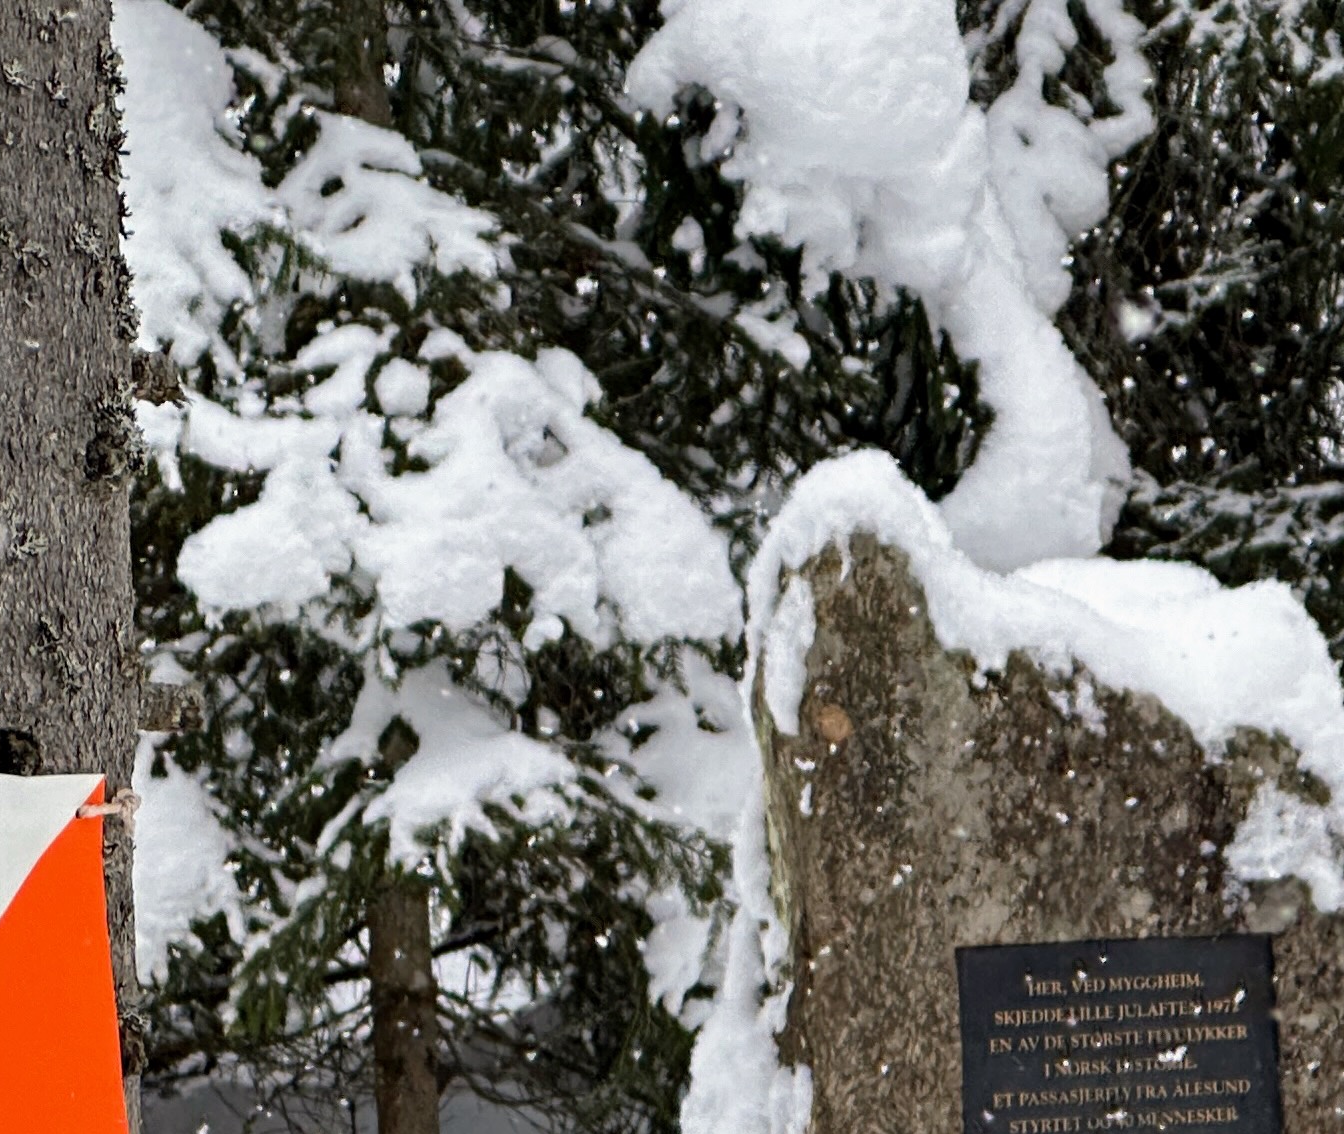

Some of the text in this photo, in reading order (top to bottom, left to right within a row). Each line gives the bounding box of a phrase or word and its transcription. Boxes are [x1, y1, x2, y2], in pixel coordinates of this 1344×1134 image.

[1027, 979, 1067, 997] HER,
[1071, 976, 1105, 993] VED
[994, 1006, 1067, 1028] SKJEDDE
[1068, 1003, 1114, 1023] LILLE
[1117, 1000, 1203, 1021] JULAFTEN
[989, 1037, 1012, 1055] EN
[1018, 1035, 1040, 1052] AV
[1044, 1033, 1066, 1050] DE
[1147, 1025, 1248, 1045] FLYULYKKER
[1044, 1055, 1198, 1078] I NORSK HSTOE.
[993, 1078, 1251, 1109] ET PASSASJERFLY FRA ÅLESUND
[1009, 1116, 1082, 1134] STYRTET
[1087, 1115, 1112, 1131] OG
[1137, 1106, 1239, 1127] MENNESKER
